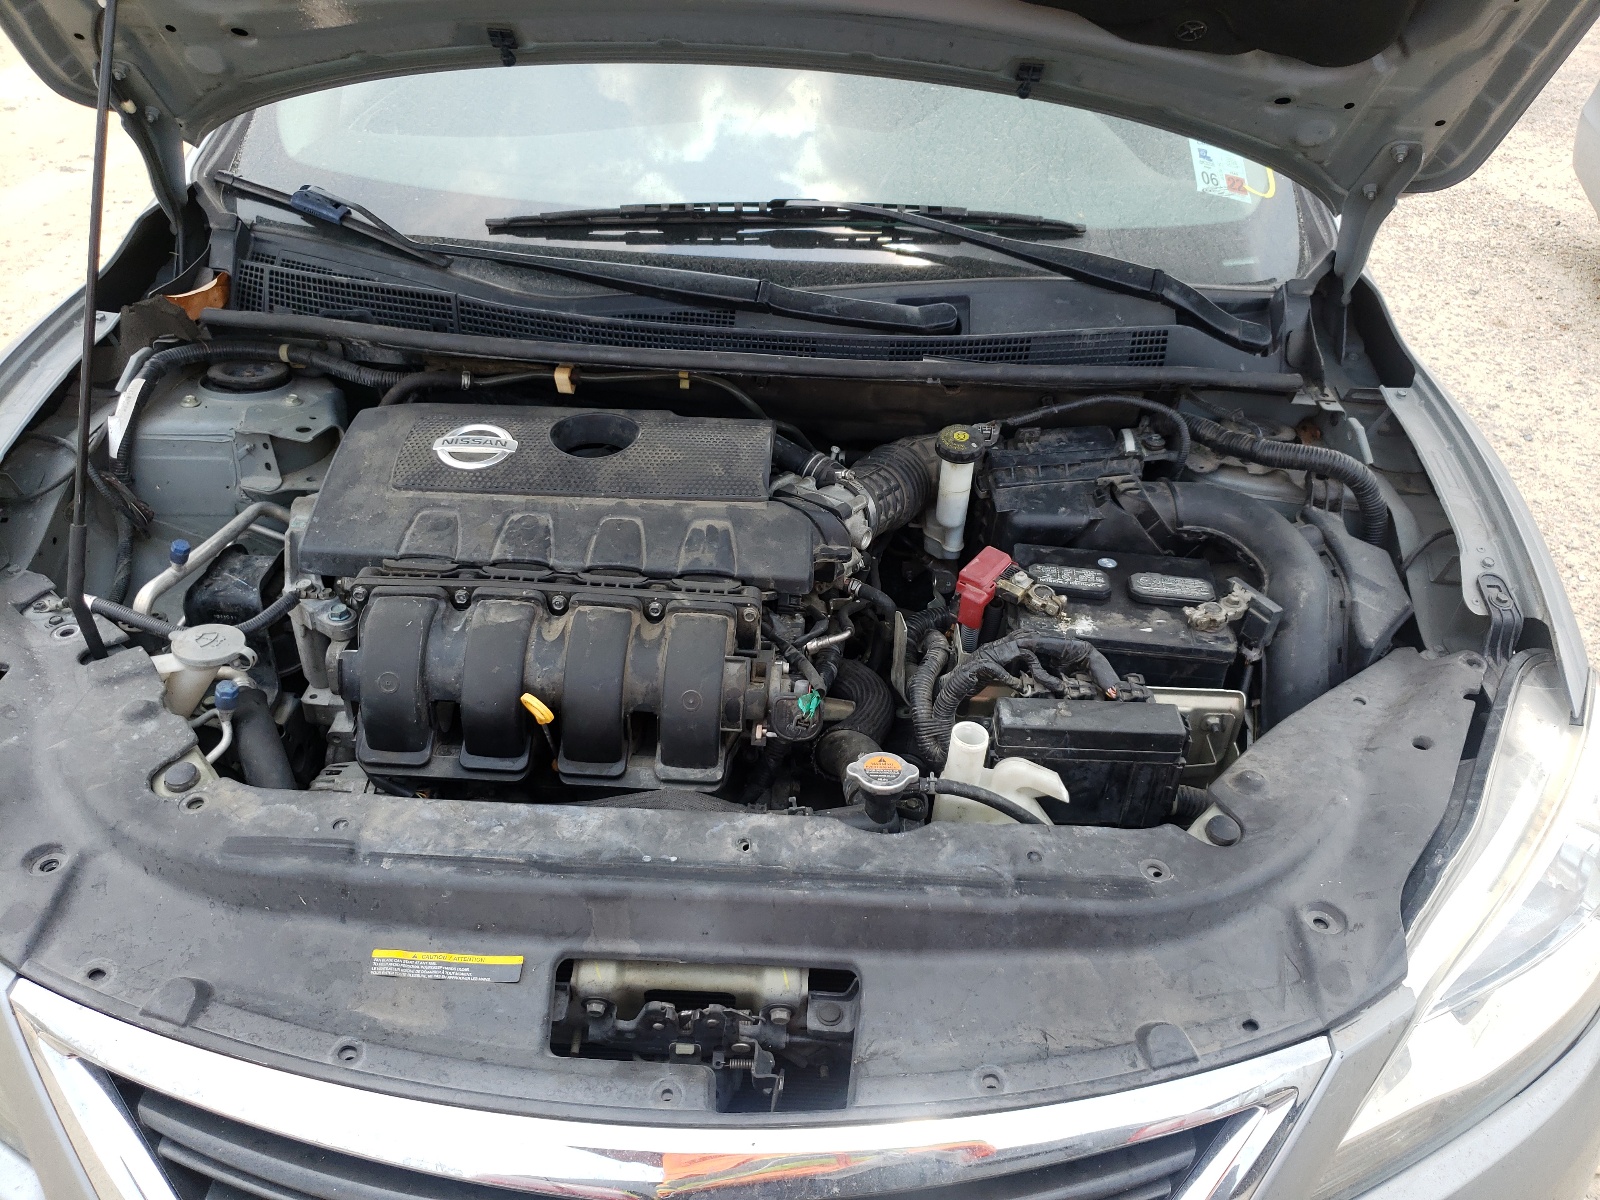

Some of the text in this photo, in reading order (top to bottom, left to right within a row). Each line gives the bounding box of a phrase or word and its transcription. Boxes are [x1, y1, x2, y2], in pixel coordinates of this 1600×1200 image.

[1201, 171, 1219, 186] 06
[1227, 176, 1245, 192] 22
[441, 438, 508, 448] NISSAN
